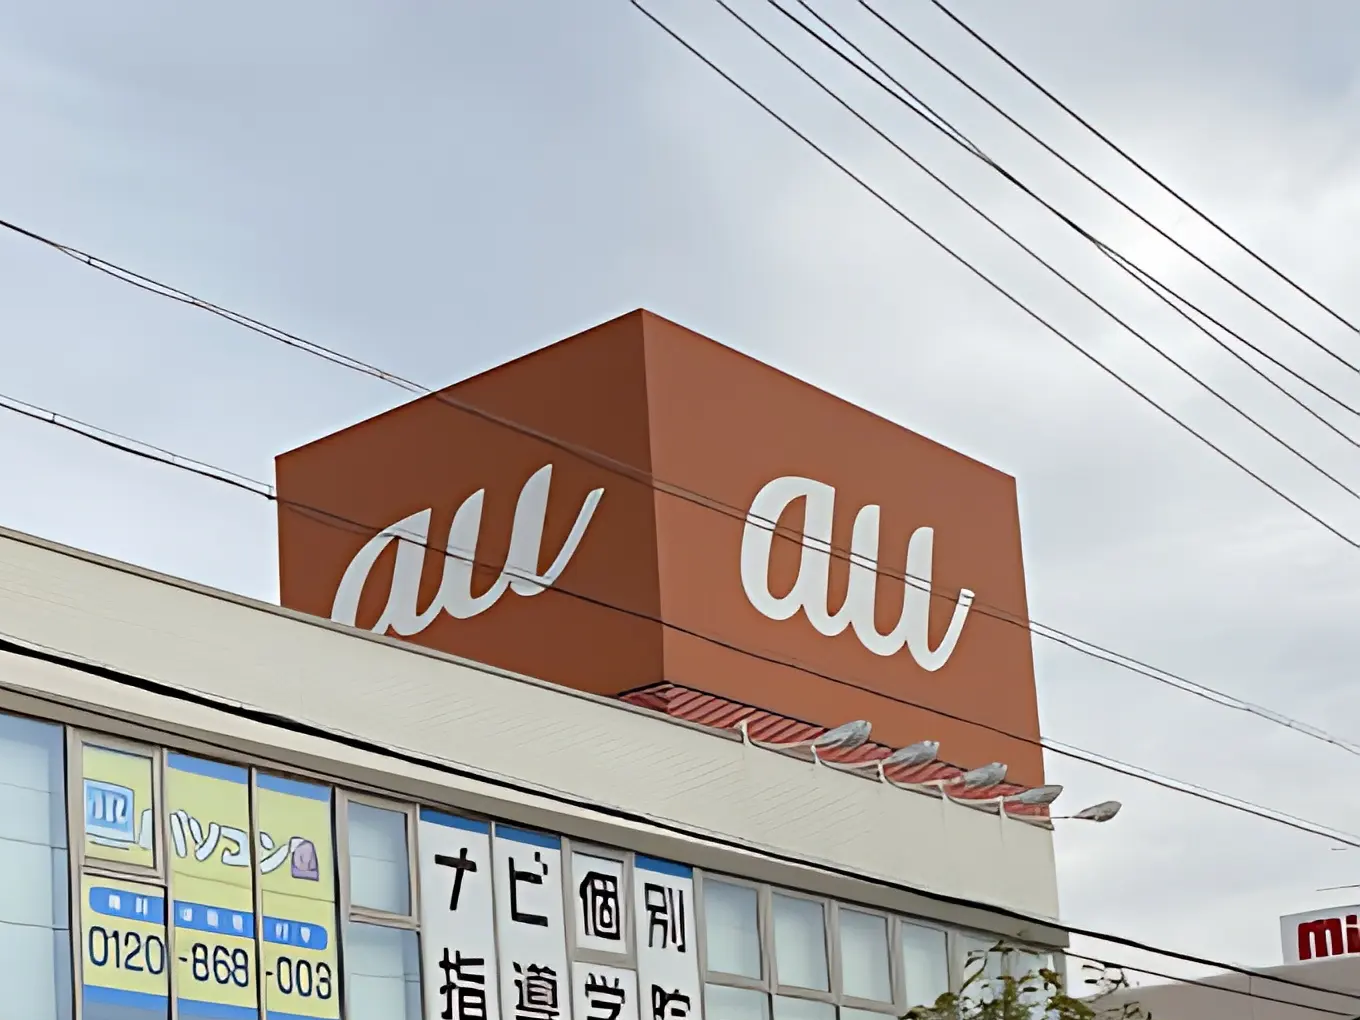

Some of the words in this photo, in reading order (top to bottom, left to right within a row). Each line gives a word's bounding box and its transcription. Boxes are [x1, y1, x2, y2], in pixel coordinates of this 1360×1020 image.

[330, 464, 604, 637] au
[740, 476, 975, 672] au
[434, 848, 687, 953] ナビ個別
